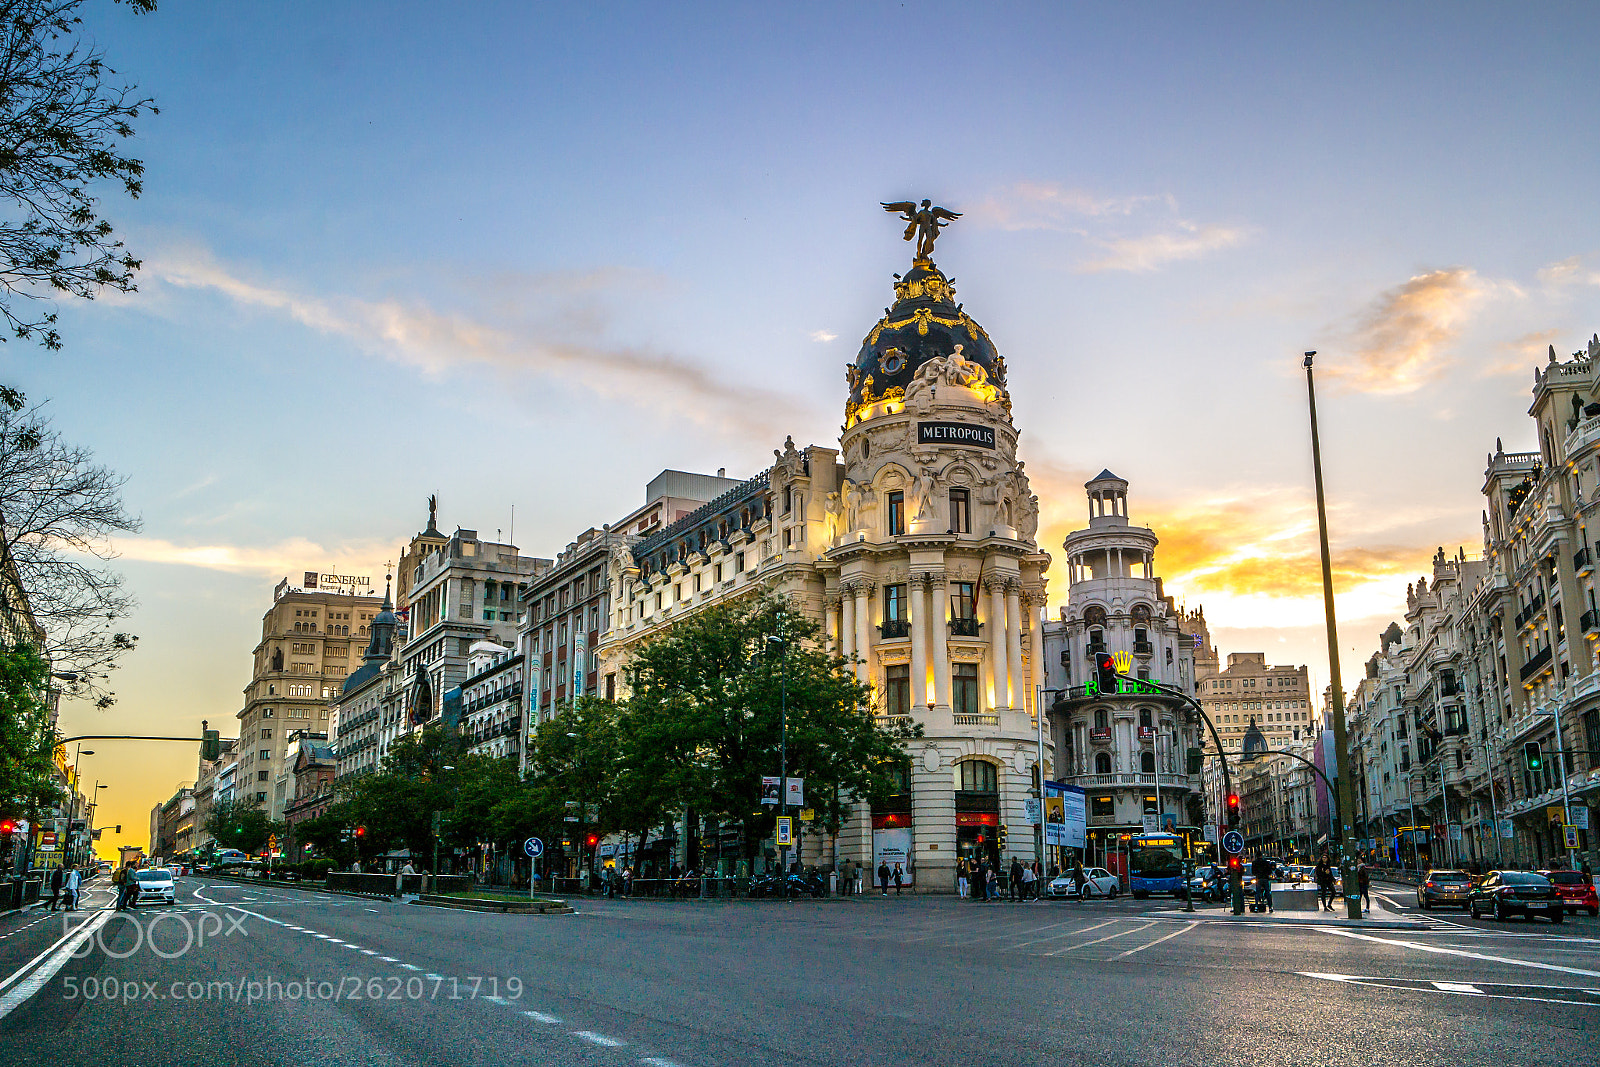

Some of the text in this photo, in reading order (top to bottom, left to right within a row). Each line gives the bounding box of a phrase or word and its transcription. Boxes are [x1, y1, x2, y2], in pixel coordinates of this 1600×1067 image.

[923, 426, 993, 444] METROPOLIS
[320, 573, 370, 586] GENERALI
[1084, 679, 1162, 696] RLEX
